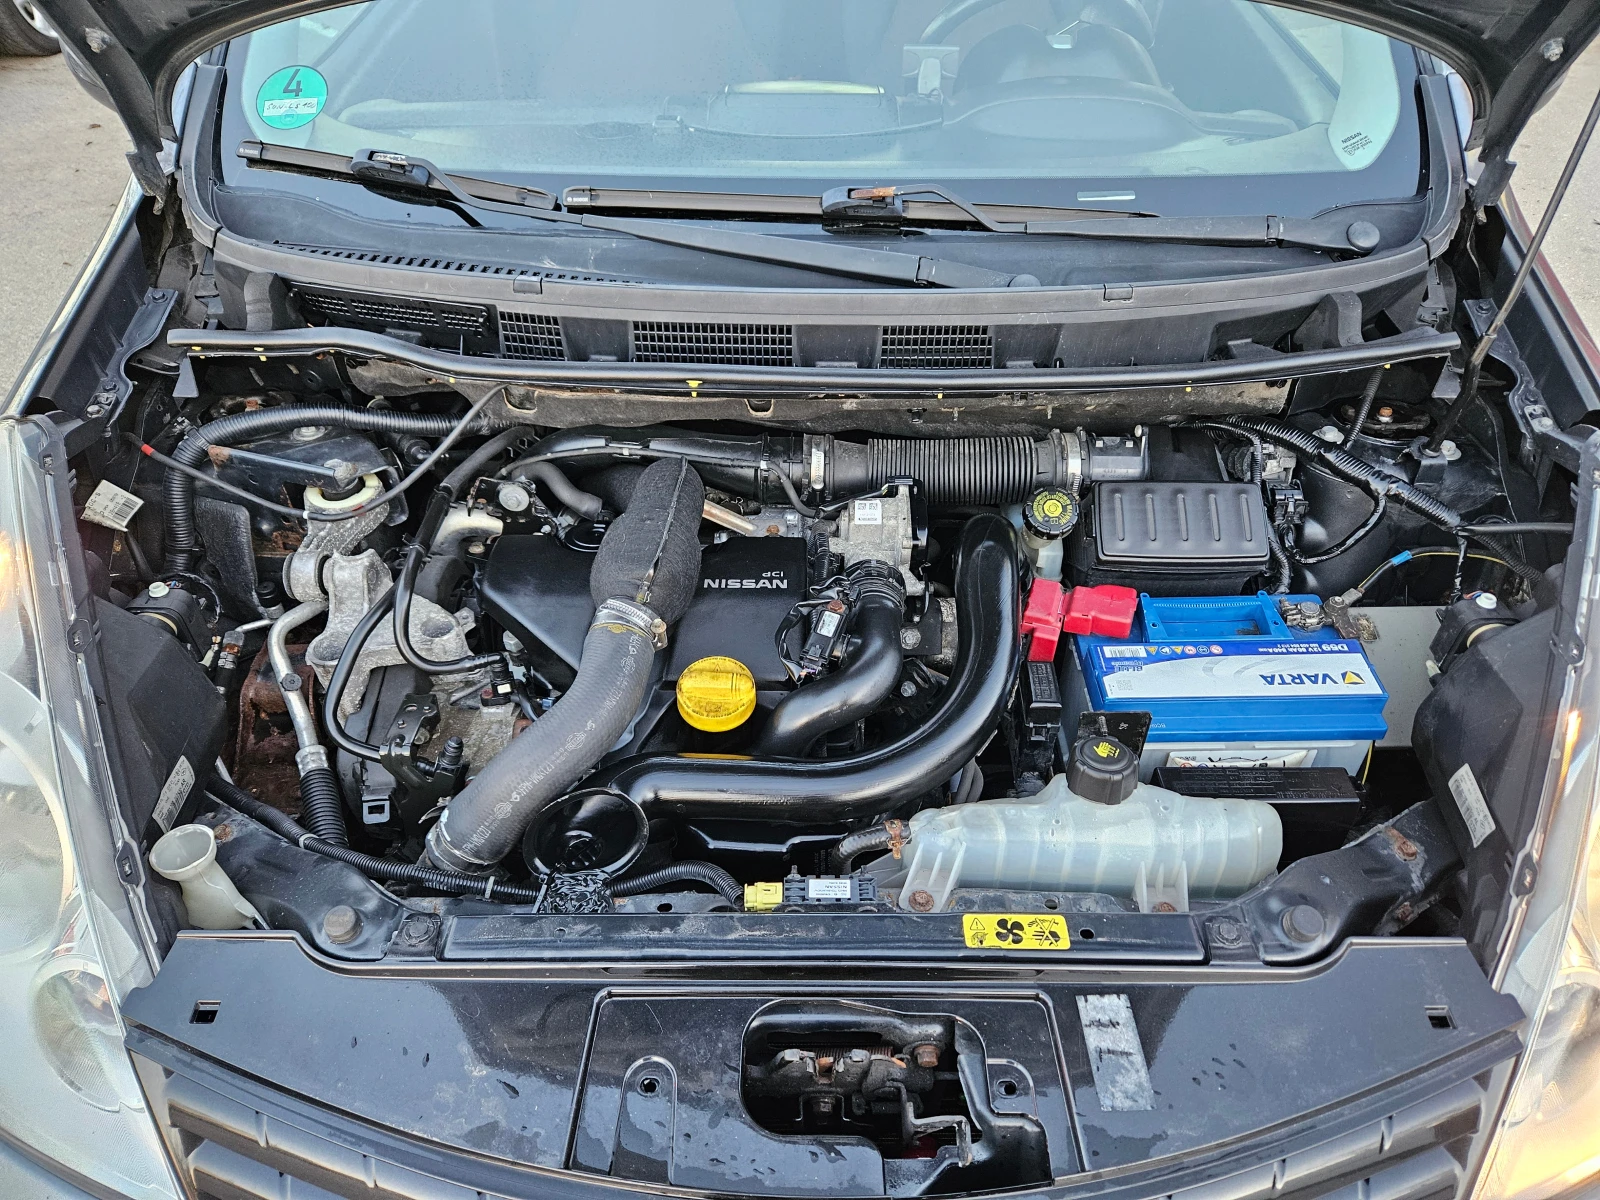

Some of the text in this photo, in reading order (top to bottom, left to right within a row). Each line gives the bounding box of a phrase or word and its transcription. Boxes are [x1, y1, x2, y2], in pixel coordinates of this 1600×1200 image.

[283, 69, 302, 97] 4
[703, 579, 788, 589] NISSAN
[1321, 643, 1349, 652] D59
[1259, 673, 1339, 685] VARTA
